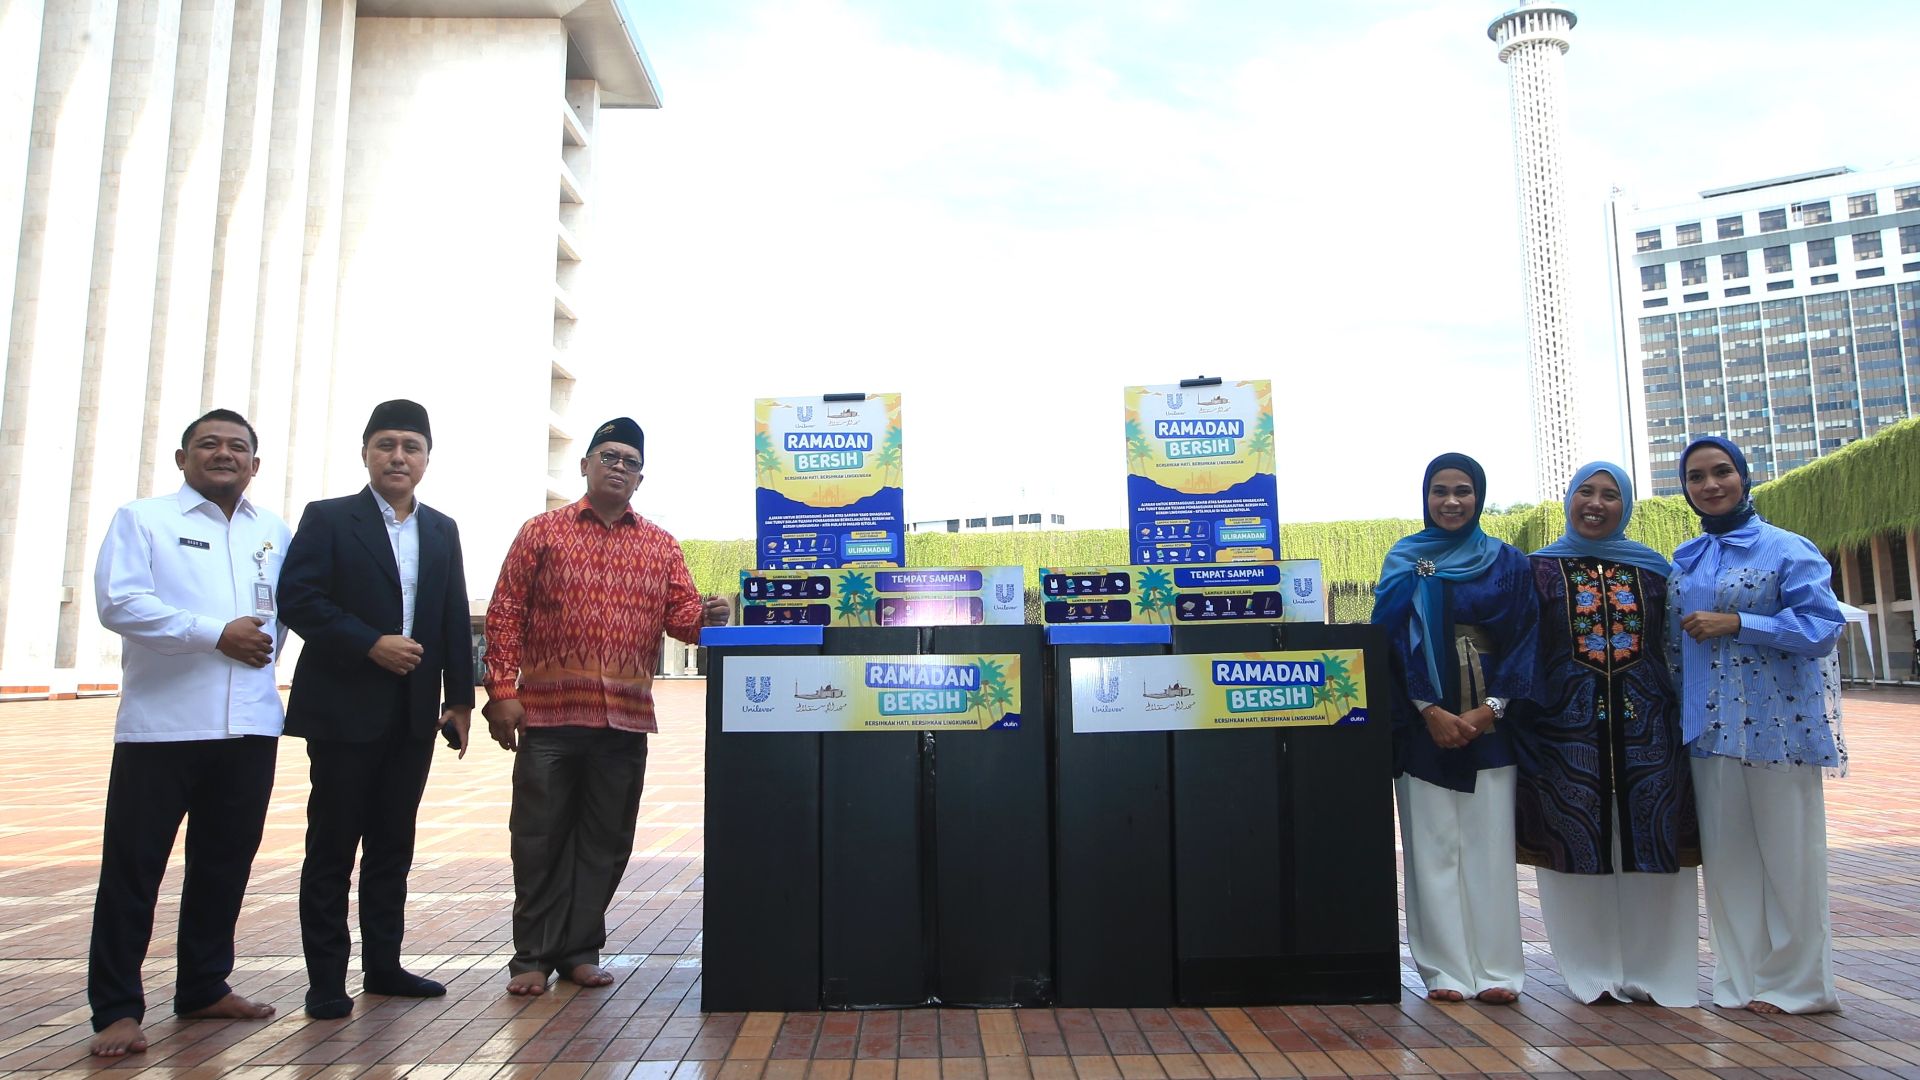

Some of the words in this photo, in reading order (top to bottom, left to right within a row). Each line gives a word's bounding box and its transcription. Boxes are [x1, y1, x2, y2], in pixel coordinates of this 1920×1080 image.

[1159, 421, 1239, 436] RAMADAN
[788, 434, 868, 448] RAMADAN
[1170, 439, 1229, 456] BERSIH
[798, 452, 858, 470] BERSIH
[892, 575, 926, 583] TEMPAT
[929, 574, 966, 583] SAMPAH
[1190, 570, 1226, 579] TEMPAT
[1227, 569, 1264, 578] SAMPAH
[870, 666, 974, 687] RAMADAN
[1216, 663, 1319, 682] RAMADAN
[884, 691, 960, 712] BERSIH
[1231, 687, 1307, 709] BERSIH
